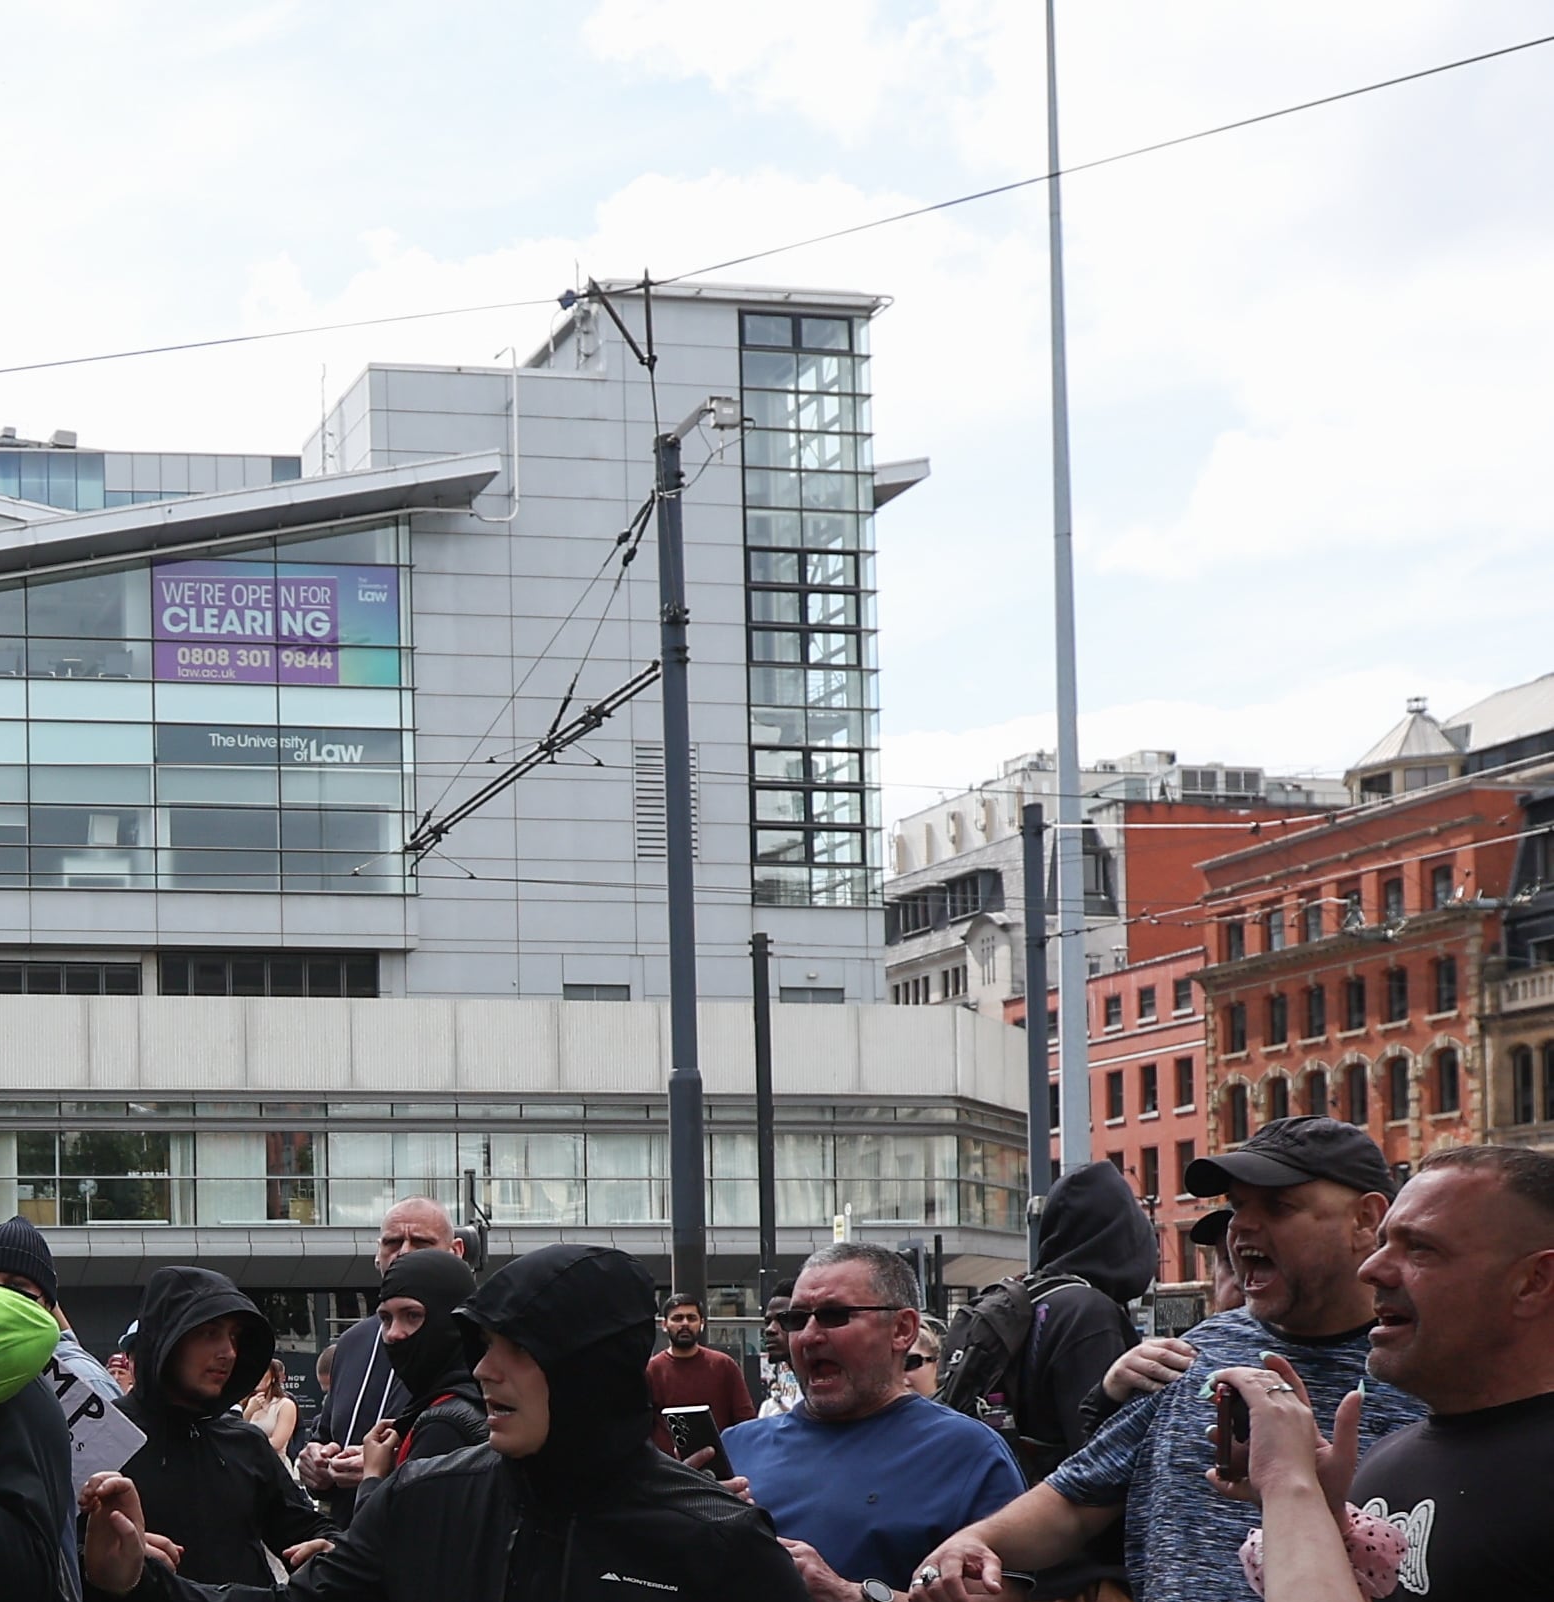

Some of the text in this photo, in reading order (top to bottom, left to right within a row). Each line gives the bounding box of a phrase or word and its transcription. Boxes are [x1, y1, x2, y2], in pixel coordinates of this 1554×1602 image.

[161, 581, 331, 608] WE'RE OPEN FOR
[358, 590, 388, 602] Law
[162, 606, 332, 638] CLEARING
[177, 647, 333, 670] 0808 301 9844
[177, 666, 237, 680] law.ac.uk
[208, 733, 308, 750] The University
[293, 738, 364, 763] of Law
[622, 1576, 679, 1592] MONTERRAIN
